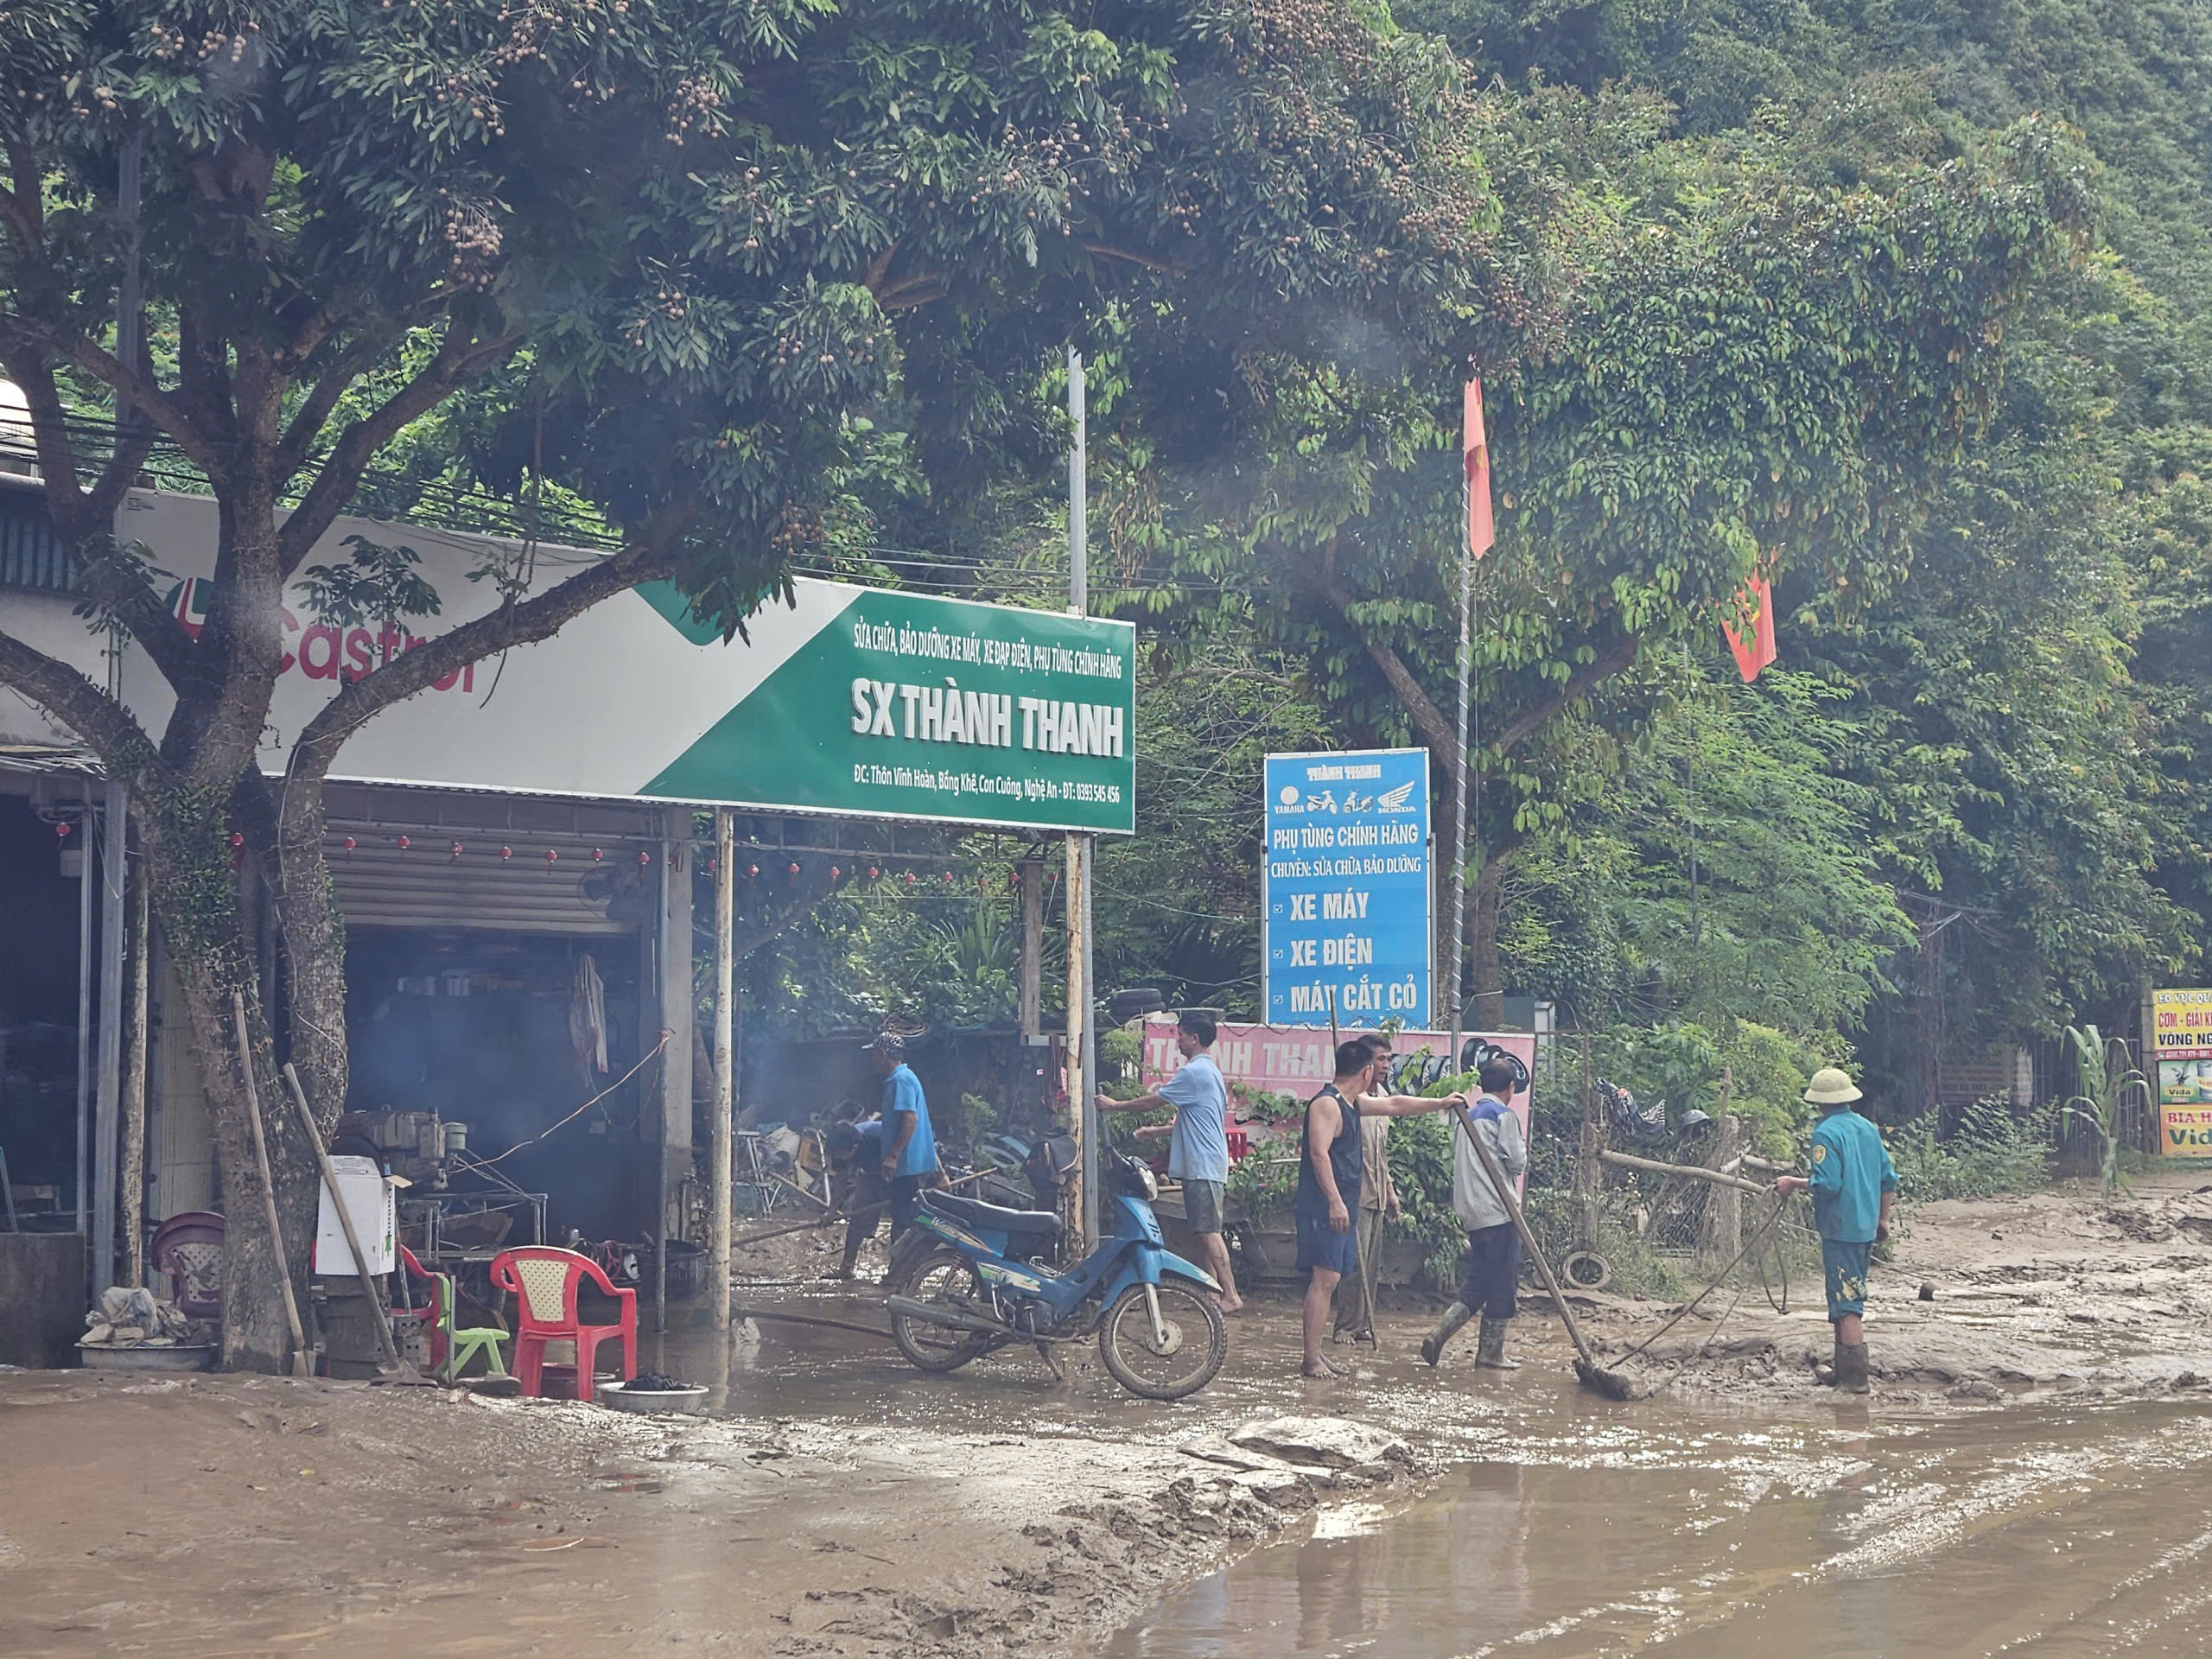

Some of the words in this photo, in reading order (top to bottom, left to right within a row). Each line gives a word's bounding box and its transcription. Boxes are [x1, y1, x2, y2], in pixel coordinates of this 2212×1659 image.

[279, 607, 474, 693] astr
[854, 615, 871, 649] SỬA
[873, 620, 898, 657] CHỮA,
[899, 620, 917, 655] BẢO
[918, 626, 950, 659] DƯỠNG
[950, 635, 961, 661] XE
[963, 632, 981, 666] MÁY,
[983, 639, 994, 664] XE
[995, 640, 1010, 671] ĐẠP
[1011, 637, 1033, 674] ĐIỆN,
[1033, 645, 1051, 677] PHỤ
[1052, 642, 1073, 673] TÙNG
[1074, 645, 1099, 677] CHÍNH
[1100, 648, 1122, 679] HÃNG
[851, 678, 896, 737] SX
[899, 677, 1011, 747] THÀNH
[1018, 696, 1123, 757] THANH
[854, 764, 869, 783] ĐC:
[870, 765, 893, 785] Thôn
[893, 766, 912, 787] Vĩnh
[913, 768, 938, 793] Hoàn,
[961, 772, 978, 795] Khê,
[978, 774, 994, 793] Con
[995, 776, 1023, 801] Cuông,
[1024, 779, 1046, 803] Nghệ
[1046, 781, 1058, 798] An
[1063, 782, 1076, 800] ĐT:
[1076, 783, 1093, 802] 0393
[1093, 785, 1106, 803] 545
[1107, 785, 1120, 803] 456
[1274, 804, 1305, 815] YAMAHA
[1274, 829, 1299, 855] PHỤ
[1300, 823, 1334, 849] TÙNG
[1338, 819, 1377, 847] CHÍNH
[1381, 819, 1419, 845] HÃNG
[1271, 857, 1312, 878] CHUYÊN:
[1313, 855, 1332, 876] SỬA
[1334, 856, 1363, 875] CHỮA
[1363, 853, 1384, 874] BẢO
[1387, 854, 1421, 873] DƯỠNG
[1289, 894, 1317, 921] XE
[1323, 887, 1370, 920] MÁY
[1289, 939, 1317, 967] XE
[1323, 932, 1372, 970] ĐIỆN
[1291, 979, 1338, 1013] MÁY
[1343, 974, 1382, 1011] CẮT
[1389, 974, 1417, 1009] CỎ
[2158, 1013, 2177, 1027] CƠM
[2186, 1007, 2202, 1027] GIẢI
[1149, 1037, 1253, 1075] THNH
[1263, 1043, 1336, 1077] THAN
[2167, 1112, 2196, 1123] BIA
